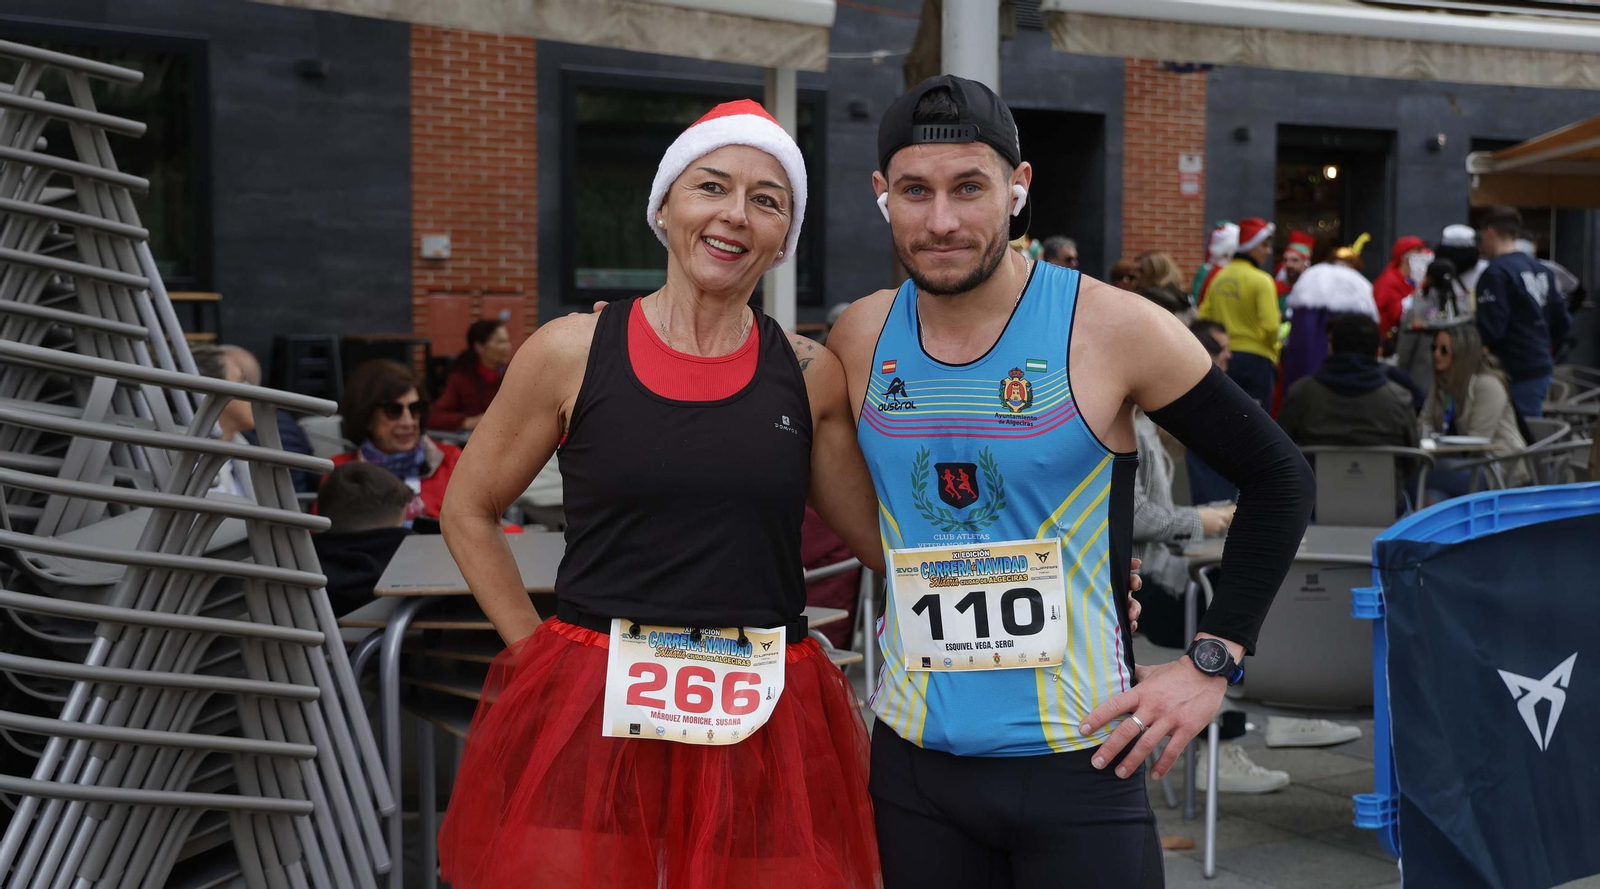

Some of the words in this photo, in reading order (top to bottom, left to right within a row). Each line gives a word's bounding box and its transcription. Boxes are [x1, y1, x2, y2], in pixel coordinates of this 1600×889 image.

[878, 401, 916, 412] austral
[994, 412, 1038, 422] Ayuntamiento
[1006, 419, 1034, 427] Algeciras
[952, 551, 960, 559] XI
[961, 549, 990, 559] EDICIÓN
[895, 566, 919, 574] EVOS
[921, 559, 974, 579] CARRERA
[975, 555, 1028, 577] NAVIDAD
[988, 573, 1028, 583] ALGECIRAS
[911, 587, 1045, 640] 110
[705, 636, 752, 659] NAVIDAD
[945, 641, 973, 651] ESQUIVEL
[974, 641, 994, 650] VEGA,
[995, 639, 1014, 648] SERGI
[715, 655, 751, 667] ALGECIRAS
[626, 661, 761, 715] 266
[650, 710, 681, 722] MÁRQUEZ
[682, 715, 714, 726] MORICHE,
[716, 718, 741, 726] SUSANA
